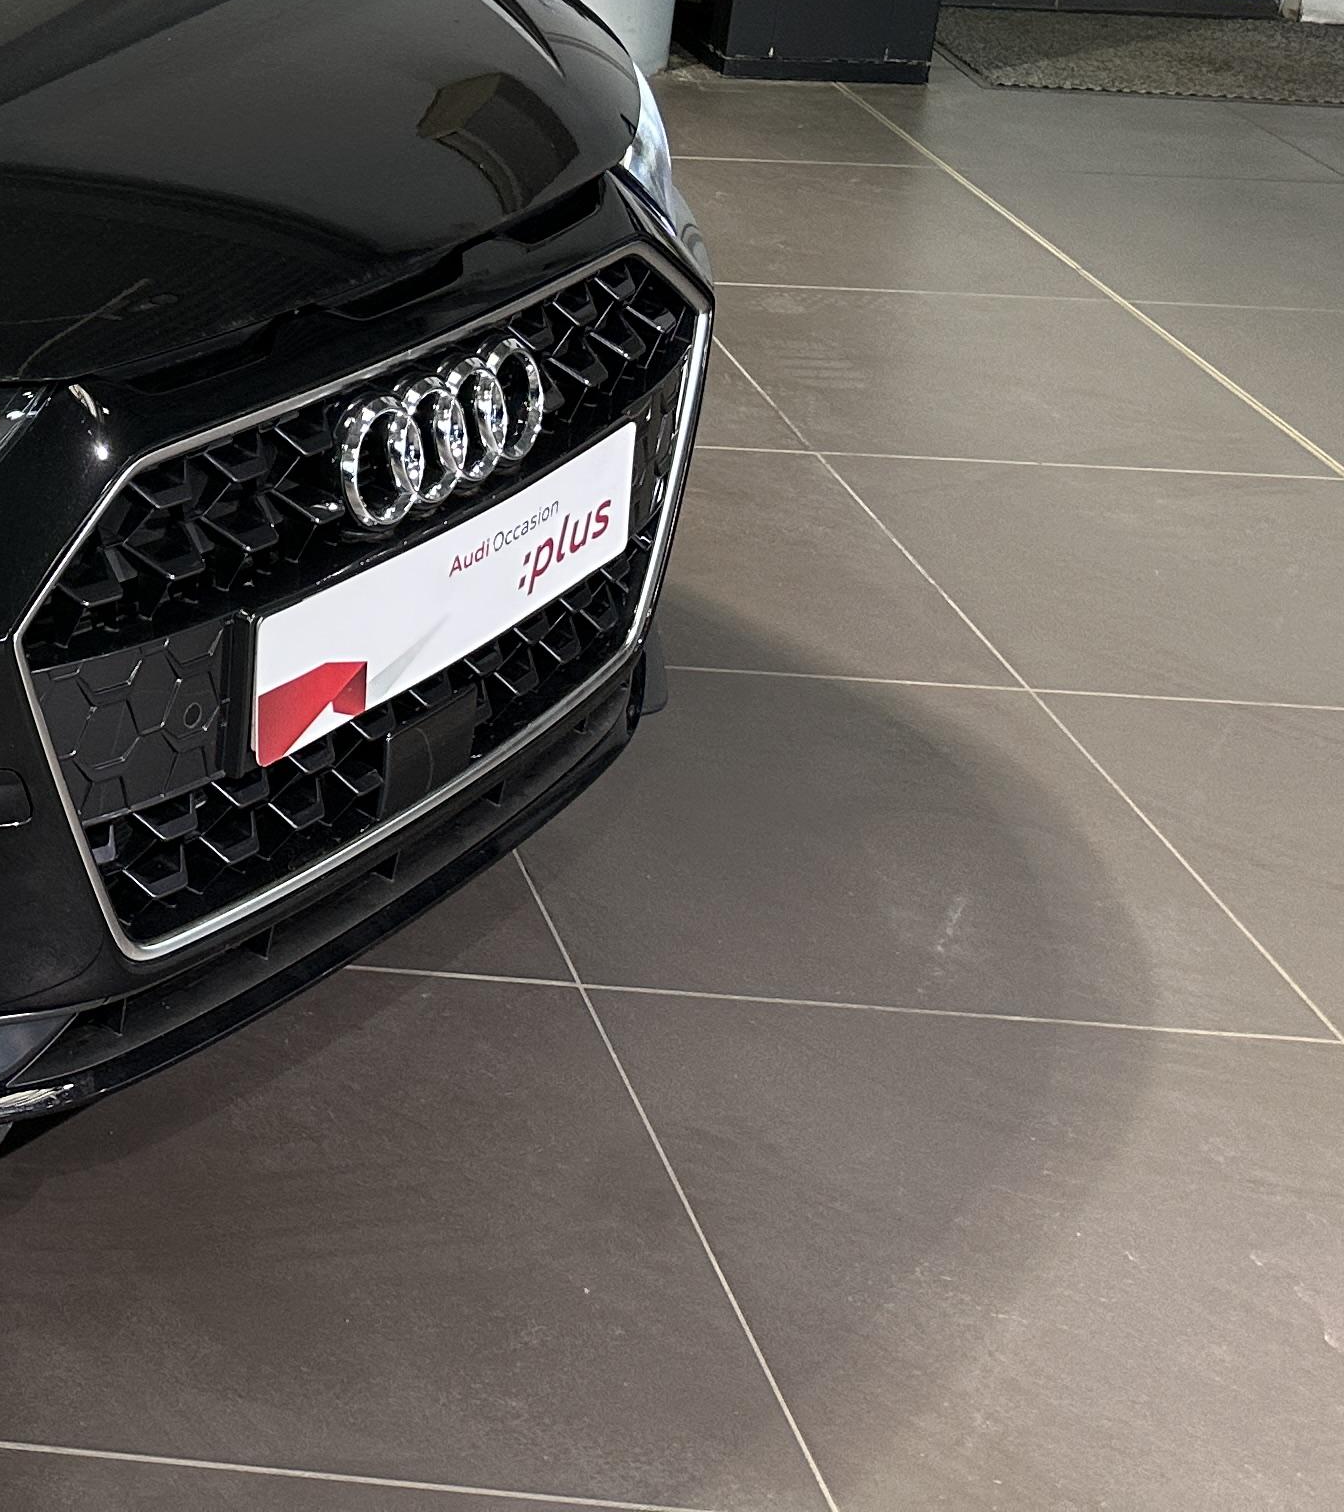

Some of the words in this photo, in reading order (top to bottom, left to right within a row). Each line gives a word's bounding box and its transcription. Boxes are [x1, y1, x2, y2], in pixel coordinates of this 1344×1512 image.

[449, 537, 491, 578] Audi
[492, 500, 560, 553] Occasion
[517, 499, 612, 596] :plus
